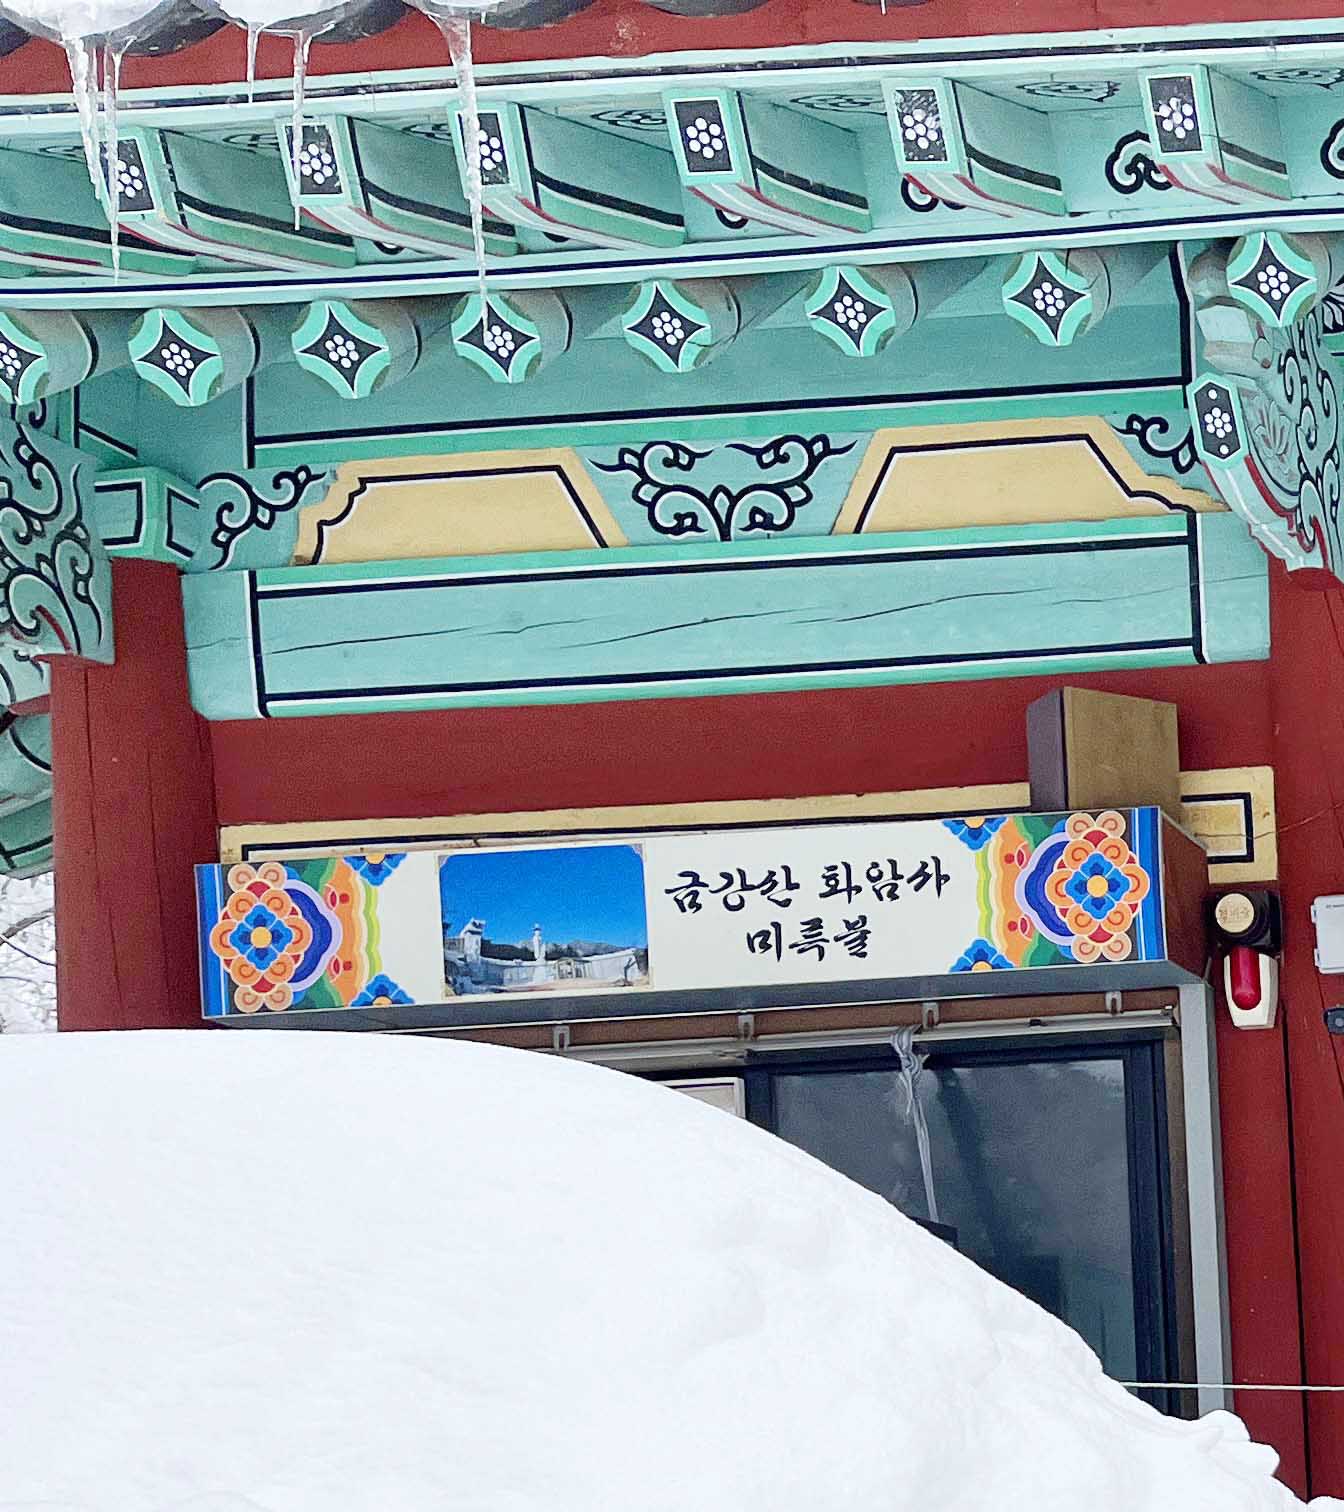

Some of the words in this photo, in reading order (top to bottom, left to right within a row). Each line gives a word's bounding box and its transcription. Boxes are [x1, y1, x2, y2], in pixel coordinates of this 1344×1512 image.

[664, 865, 801, 914] 금강산
[819, 855, 951, 905] 화암사
[746, 914, 872, 962] 미륵불
